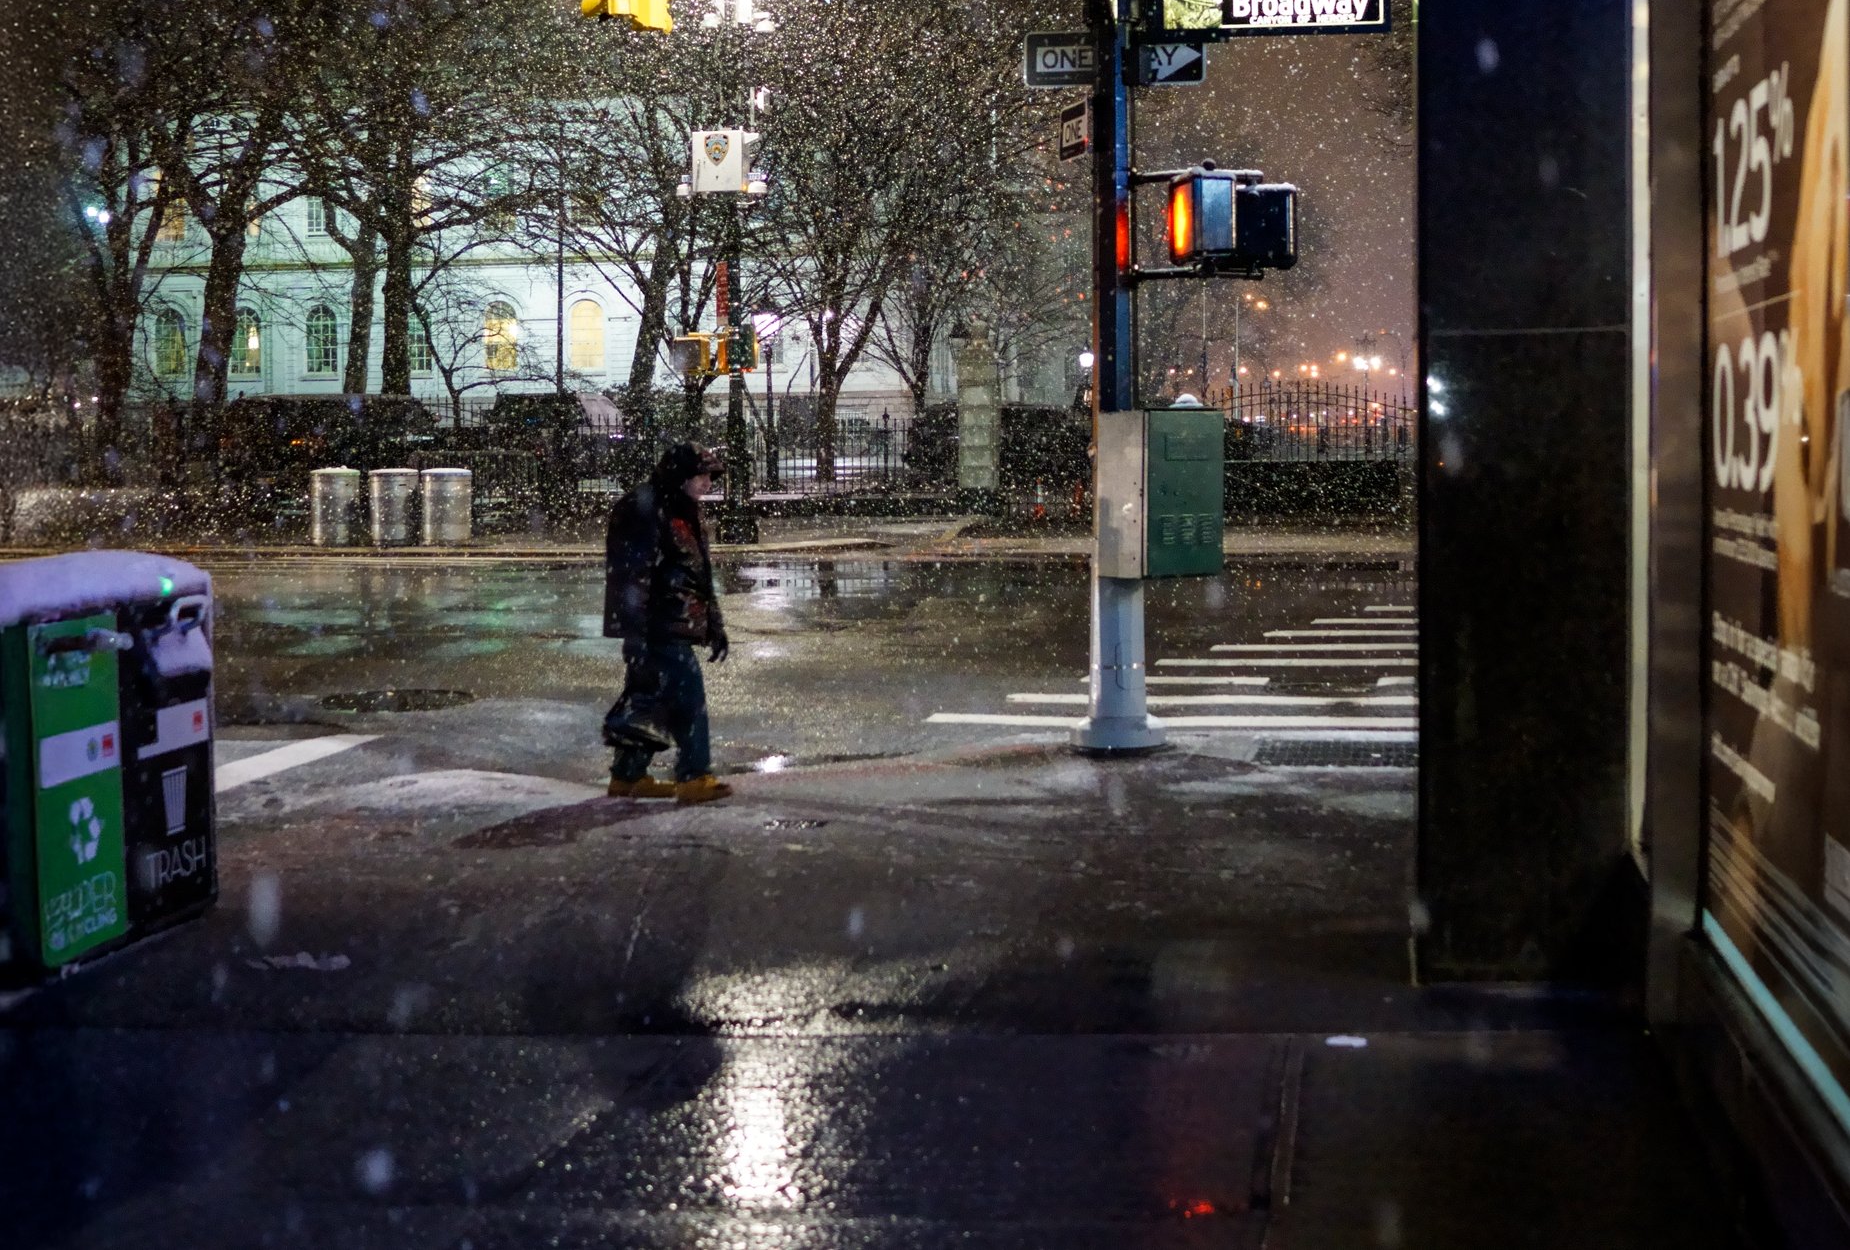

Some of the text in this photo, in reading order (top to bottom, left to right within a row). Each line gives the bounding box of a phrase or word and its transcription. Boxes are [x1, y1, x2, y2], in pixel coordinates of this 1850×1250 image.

[1250, 13, 1356, 25] CANYON OF HEROES
[1042, 46, 1178, 69] ONE AY
[1064, 119, 1083, 143] ONE
[146, 836, 206, 888] TRASH
